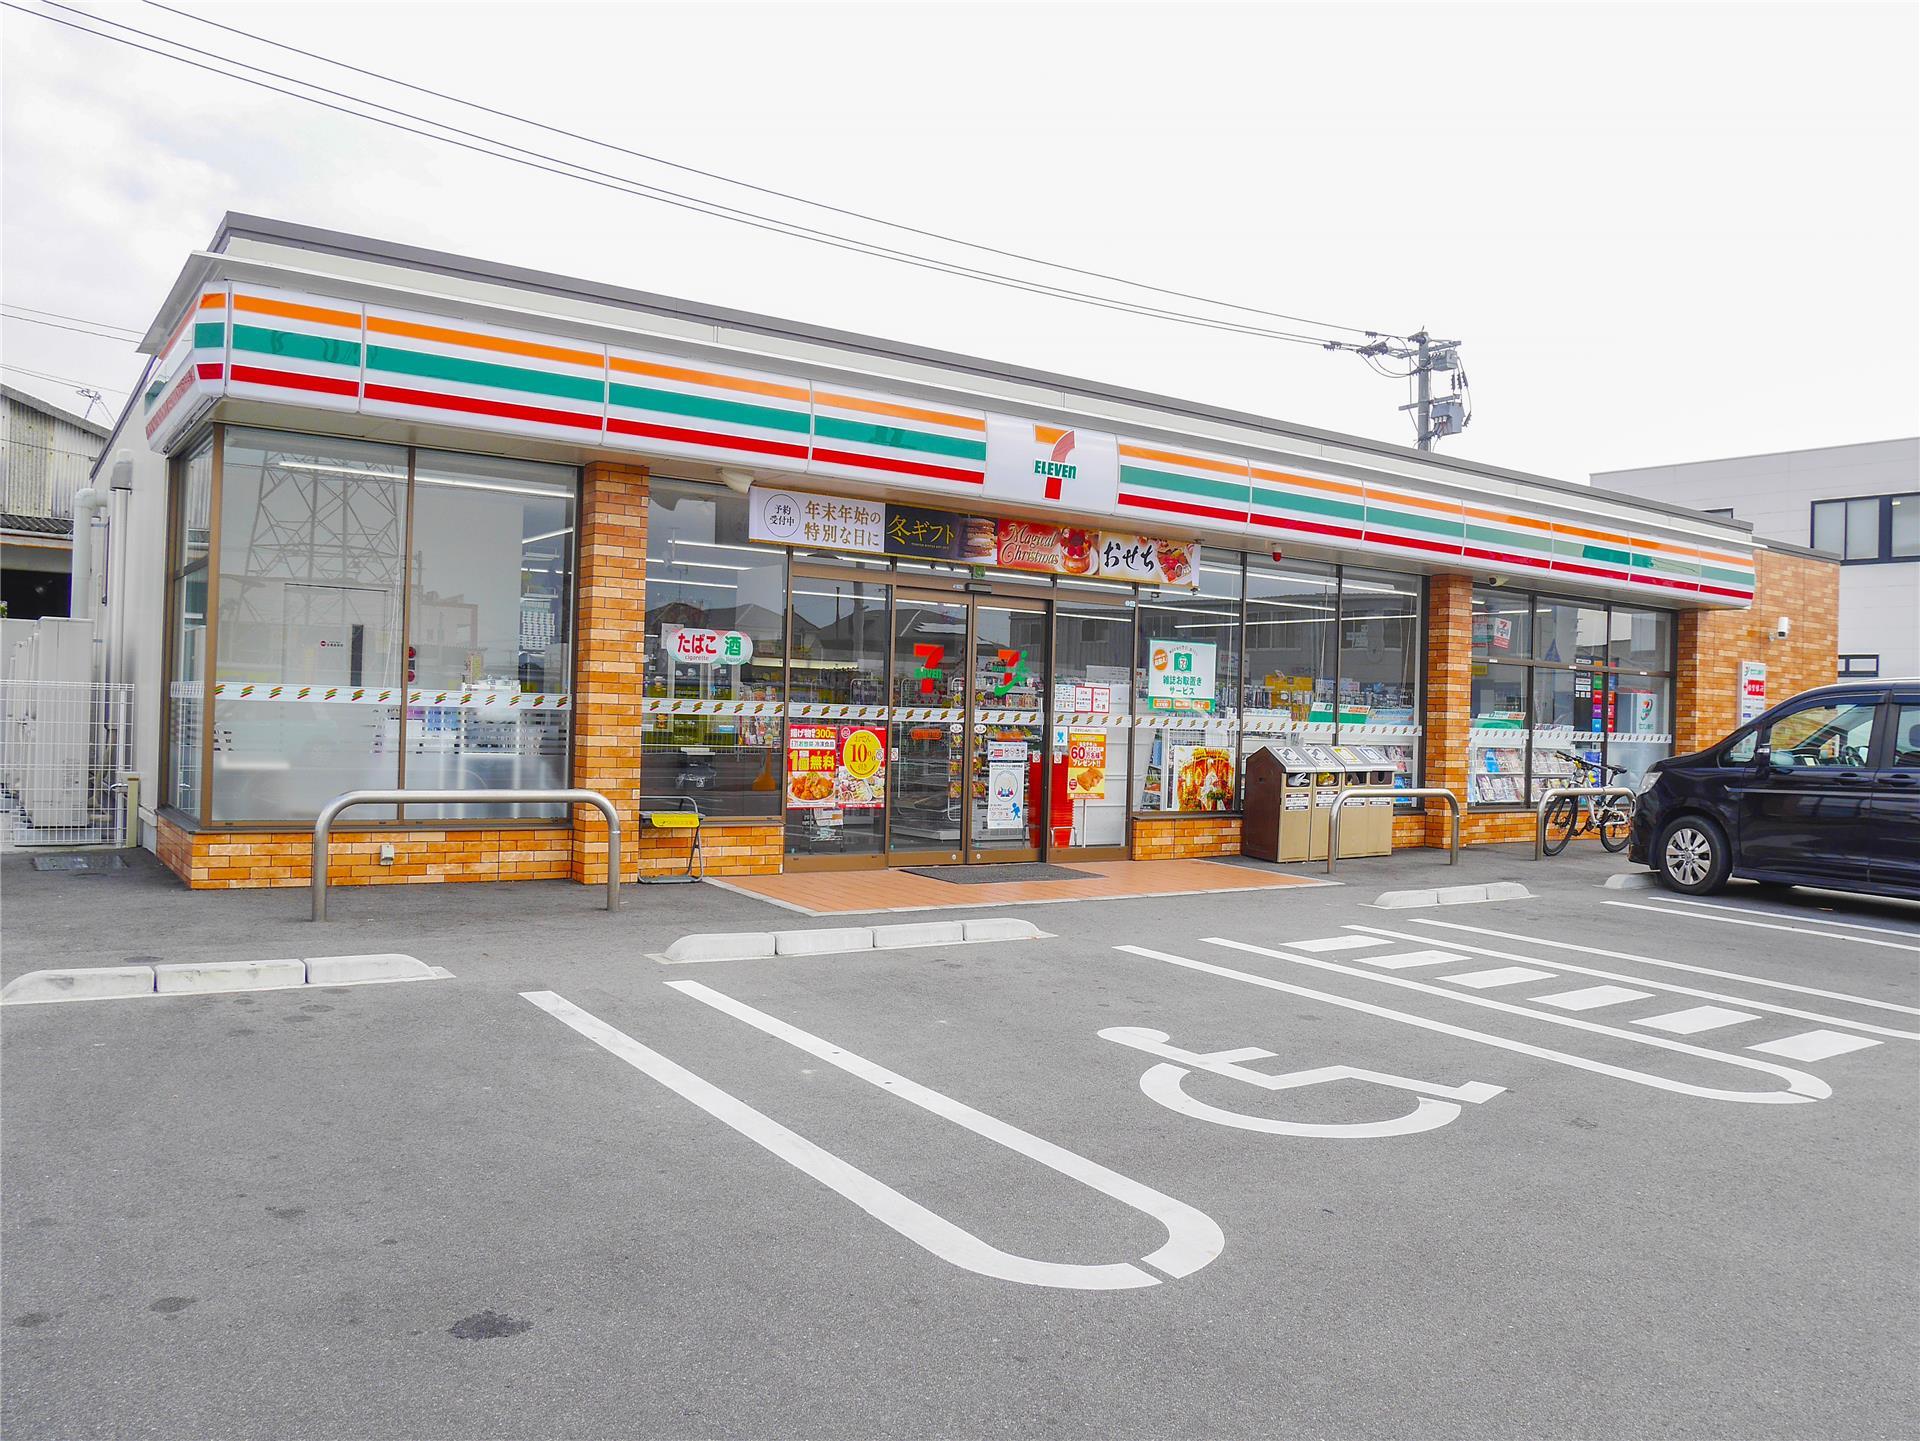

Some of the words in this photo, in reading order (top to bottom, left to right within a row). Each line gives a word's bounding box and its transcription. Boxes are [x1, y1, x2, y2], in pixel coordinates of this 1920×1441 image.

[1034, 424, 1076, 500] 7
[769, 515, 795, 527] 受付中
[775, 504, 791, 515] 予約
[804, 500, 881, 526] 年末年始の
[803, 521, 880, 547] 特別な日に
[887, 514, 955, 545] 冬ギフト
[1001, 522, 1057, 549] Magical
[1001, 542, 1060, 566] Christmas
[1103, 540, 1156, 573] おせち
[677, 632, 718, 655] たばこ
[724, 635, 742, 657] 酒
[1162, 674, 1203, 687] 雑誌お取置き
[1169, 686, 1195, 696] サービス
